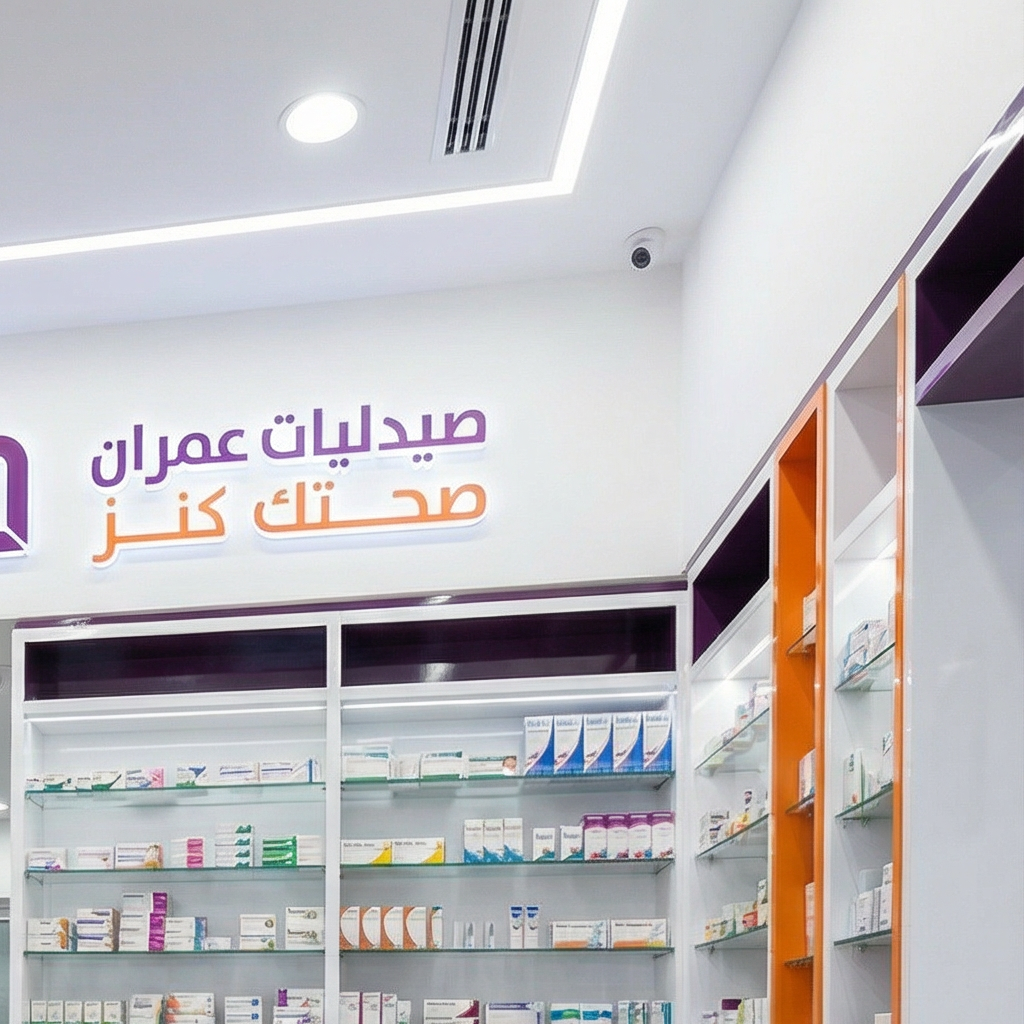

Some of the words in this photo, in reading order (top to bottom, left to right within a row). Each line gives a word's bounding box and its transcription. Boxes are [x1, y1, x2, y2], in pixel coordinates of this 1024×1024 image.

[91, 424, 248, 488] عمران
[262, 405, 486, 468] صيدليات
[92, 486, 226, 563] كنز
[254, 481, 486, 533] صحتك
